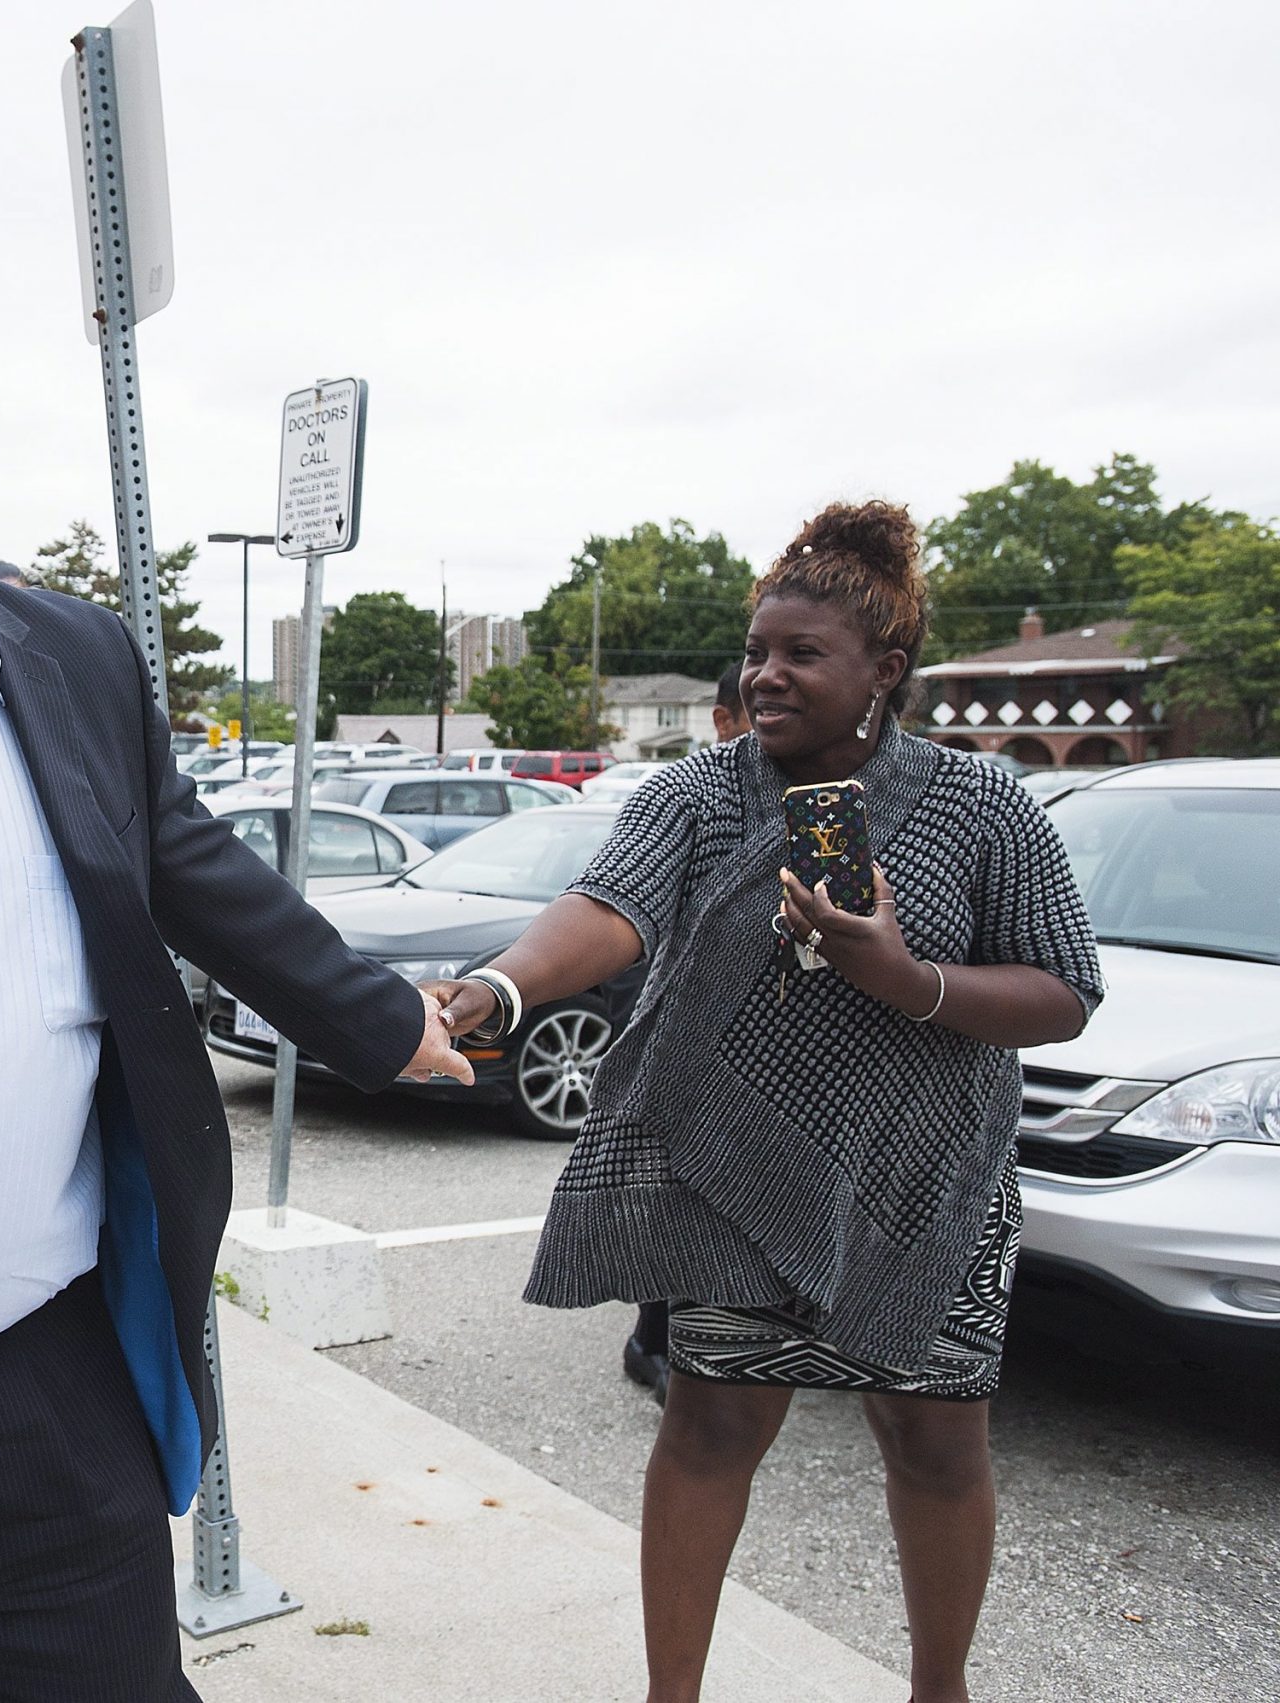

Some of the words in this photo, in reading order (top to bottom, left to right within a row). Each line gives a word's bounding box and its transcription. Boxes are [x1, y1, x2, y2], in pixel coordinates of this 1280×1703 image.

[289, 405, 348, 432] DOCTORS
[308, 430, 325, 446] ON
[300, 448, 329, 467] CALL
[289, 466, 340, 484] UNAUTHORIZED
[289, 483, 320, 496] VEHICLES
[324, 480, 338, 489] WILL
[285, 501, 292, 509] BE
[325, 491, 339, 501] AND
[297, 507, 321, 518] TOWED
[324, 504, 340, 513] AWAY
[296, 529, 326, 543] EXPENSE
